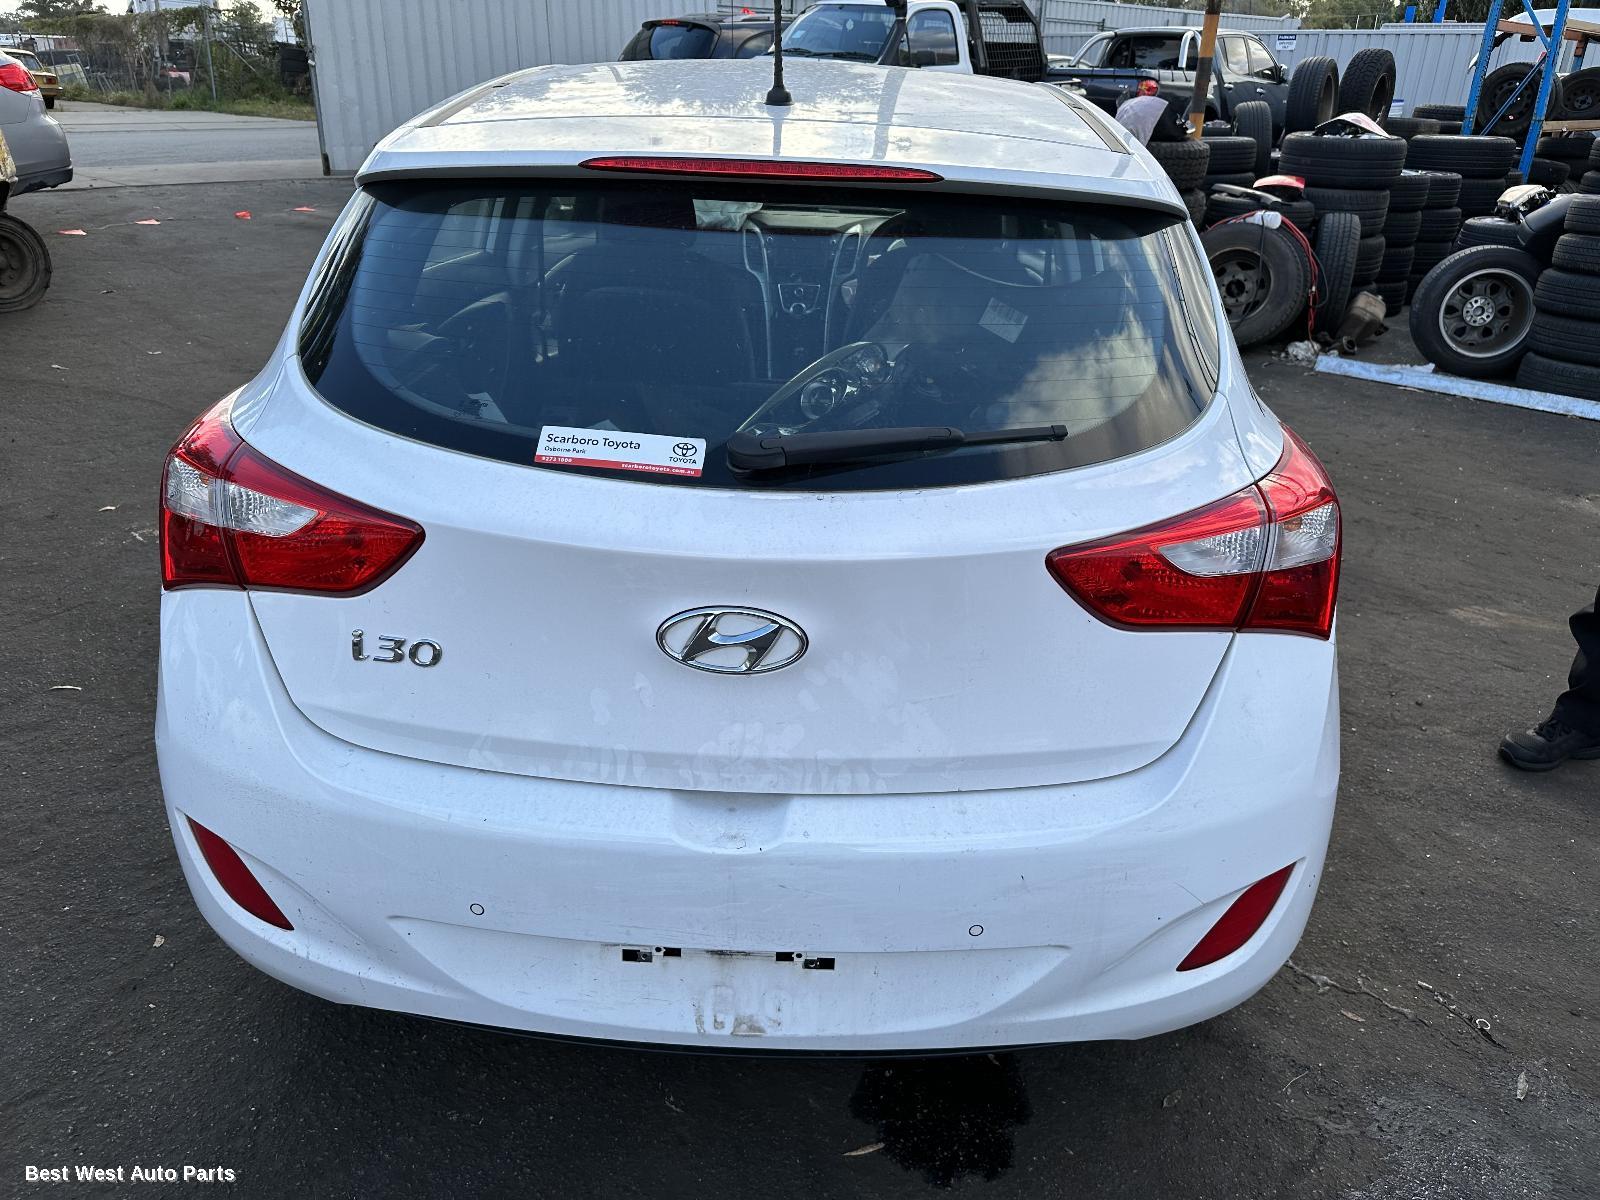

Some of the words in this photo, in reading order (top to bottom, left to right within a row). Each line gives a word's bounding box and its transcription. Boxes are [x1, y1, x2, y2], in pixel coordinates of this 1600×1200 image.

[546, 433, 599, 447] Scarboro
[602, 437, 641, 450] Toyota
[544, 445, 572, 454] Osborne
[572, 447, 586, 455] Park
[669, 456, 698, 465] TOYOTA
[621, 462, 695, 475] scarborotoyota.com.au
[351, 628, 443, 668] i30
